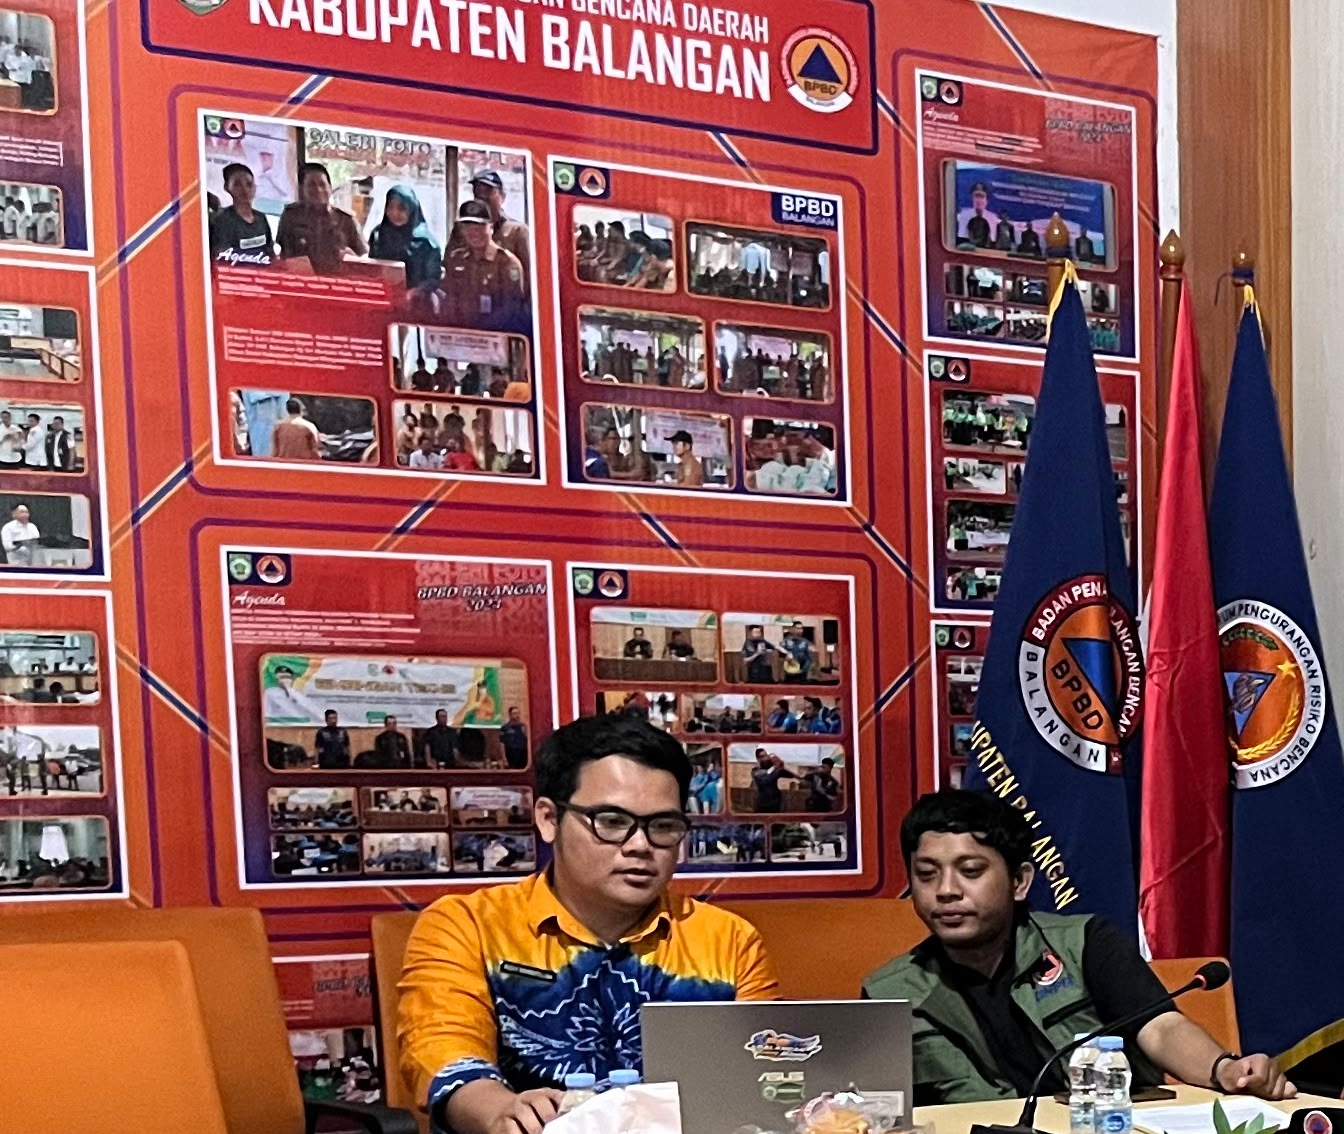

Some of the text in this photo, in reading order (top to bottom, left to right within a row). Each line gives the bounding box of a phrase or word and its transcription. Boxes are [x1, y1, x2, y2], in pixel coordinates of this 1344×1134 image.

[682, 3, 769, 44] DAERAH
[541, 13, 771, 103] BALANGAN
[781, 194, 835, 217] BPBD
[781, 210, 836, 227] BALANGAN
[216, 247, 271, 266] Agenda
[232, 591, 286, 608] Agenda
[461, 583, 548, 599] BALANGAN
[1031, 591, 1073, 641] BADAN
[1025, 651, 1101, 763] BALANGAN
[1050, 658, 1104, 731] BPBD
[1238, 602, 1322, 783] PENGURANGAN RISIKO BENCANA
